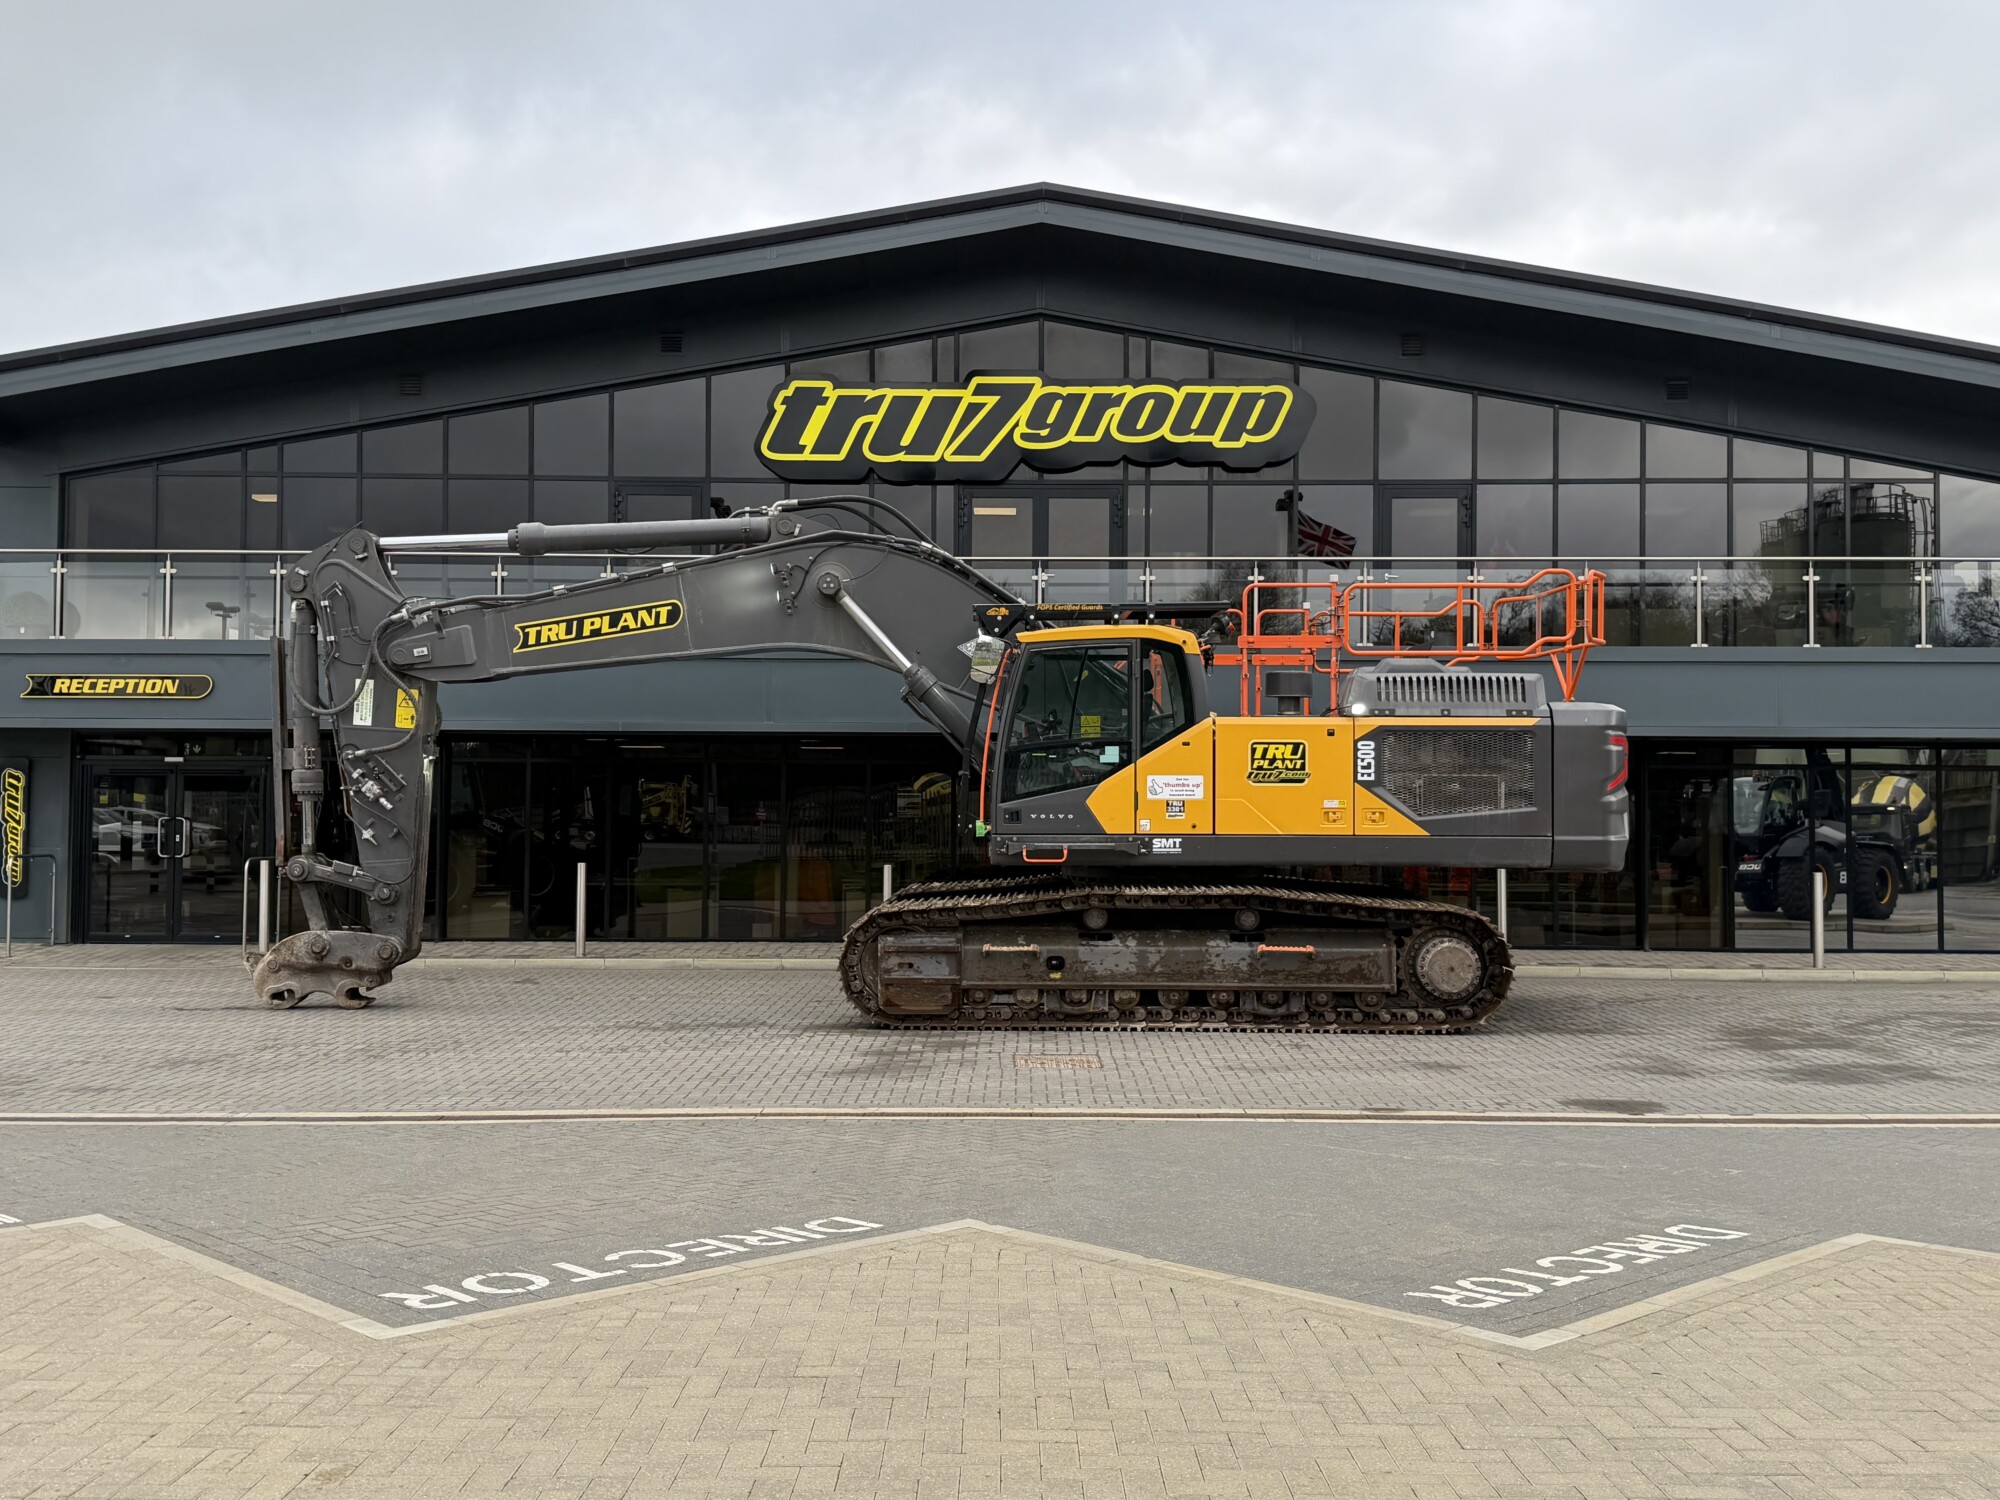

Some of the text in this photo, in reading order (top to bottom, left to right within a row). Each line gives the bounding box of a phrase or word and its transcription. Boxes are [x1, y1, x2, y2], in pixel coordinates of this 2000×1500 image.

[761, 376, 1294, 463] tru7group
[1053, 603, 1080, 612] Certified
[525, 606, 672, 645] TRU PLANT
[53, 678, 179, 694] RECEPTION
[1252, 744, 1304, 759] TRU
[1252, 759, 1305, 769] PLANT
[1357, 741, 1375, 780] EC500
[1152, 838, 1182, 848] SMT
[378, 1215, 885, 1310] DIRECTOR
[1403, 1223, 1751, 1309] DIRECTOR
